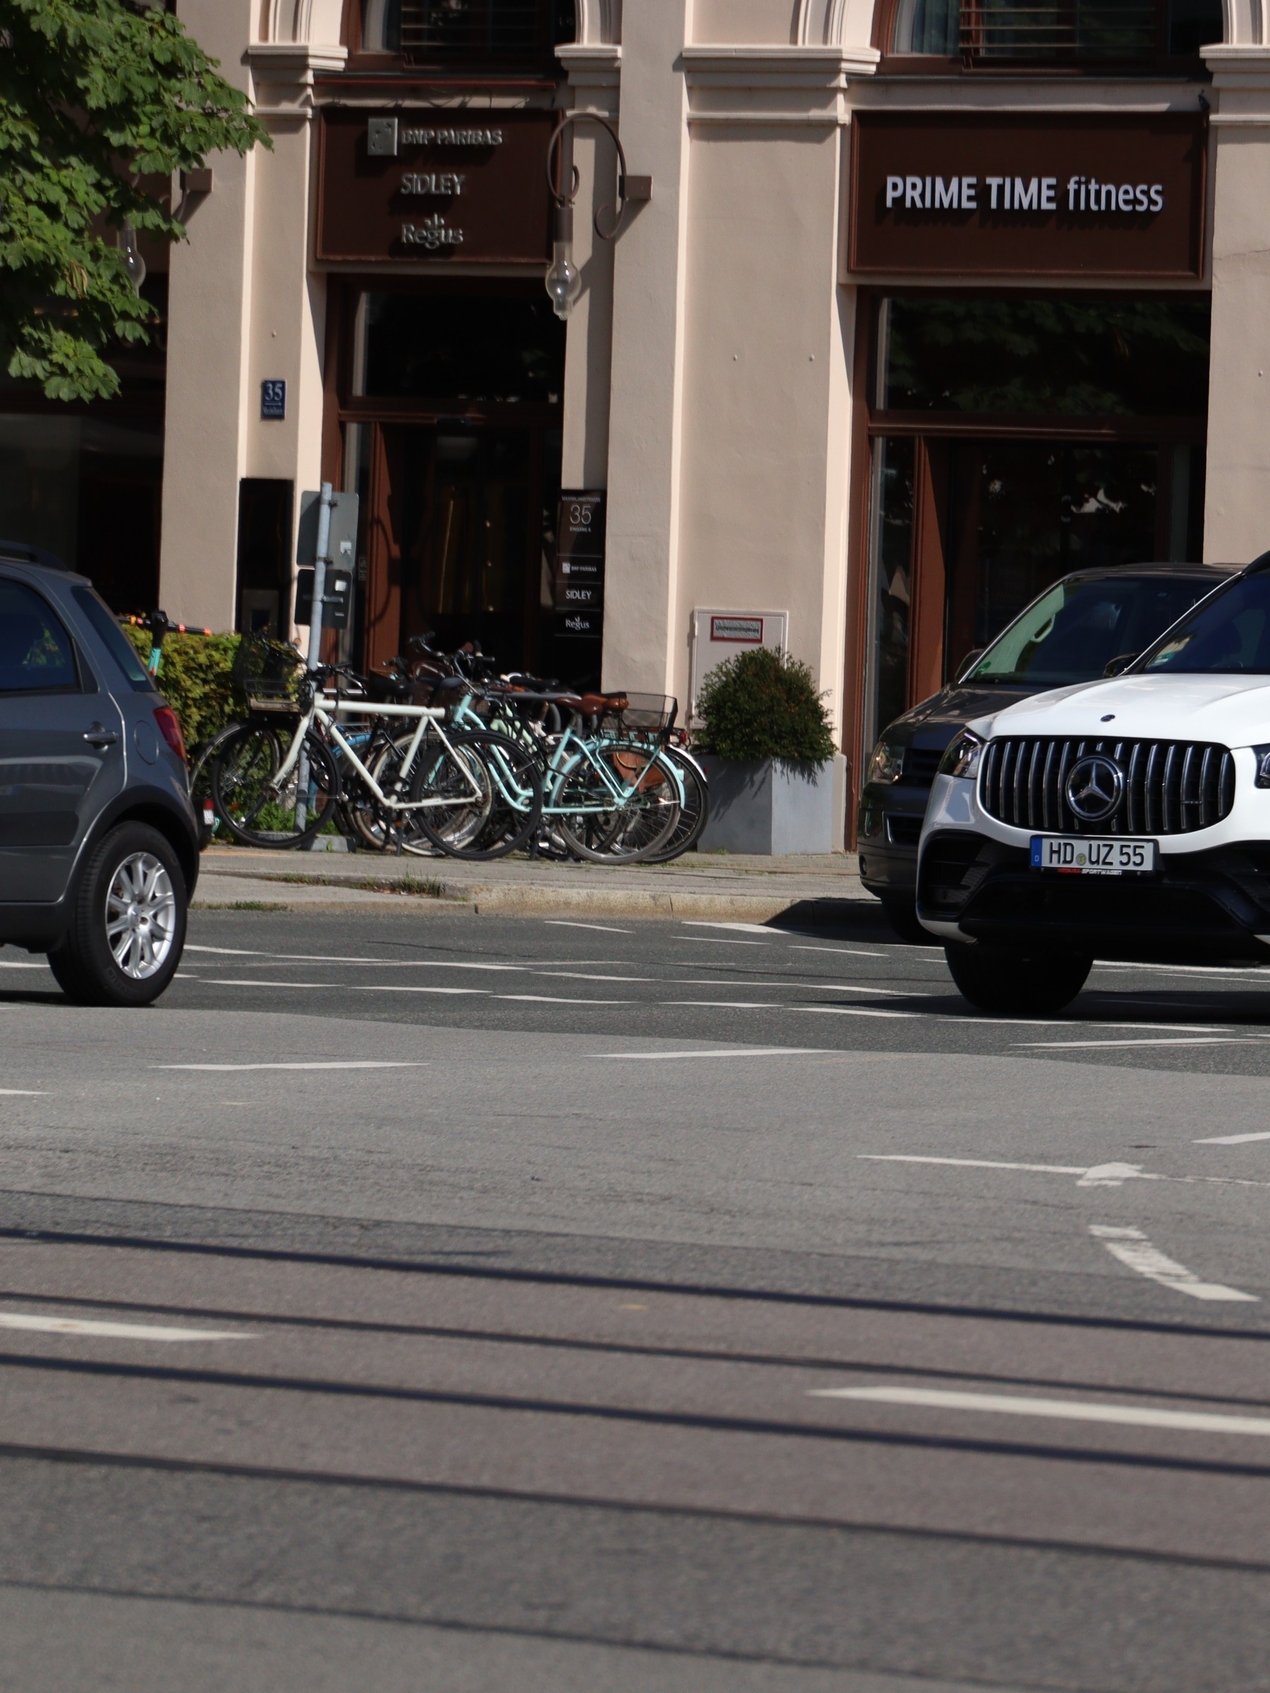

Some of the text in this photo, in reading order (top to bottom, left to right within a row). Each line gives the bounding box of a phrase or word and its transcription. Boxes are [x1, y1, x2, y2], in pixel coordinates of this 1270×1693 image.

[401, 128, 503, 145] BNP PARIBAS
[401, 173, 466, 195] SIDLEY
[886, 175, 1163, 212] PRIME TIME fitness
[401, 222, 464, 249] Regus
[264, 383, 283, 401] 35
[570, 504, 592, 525] 35
[566, 590, 592, 600] SIDLEY
[565, 618, 590, 631] Regus
[1048, 841, 1145, 867] HD UZ 55
